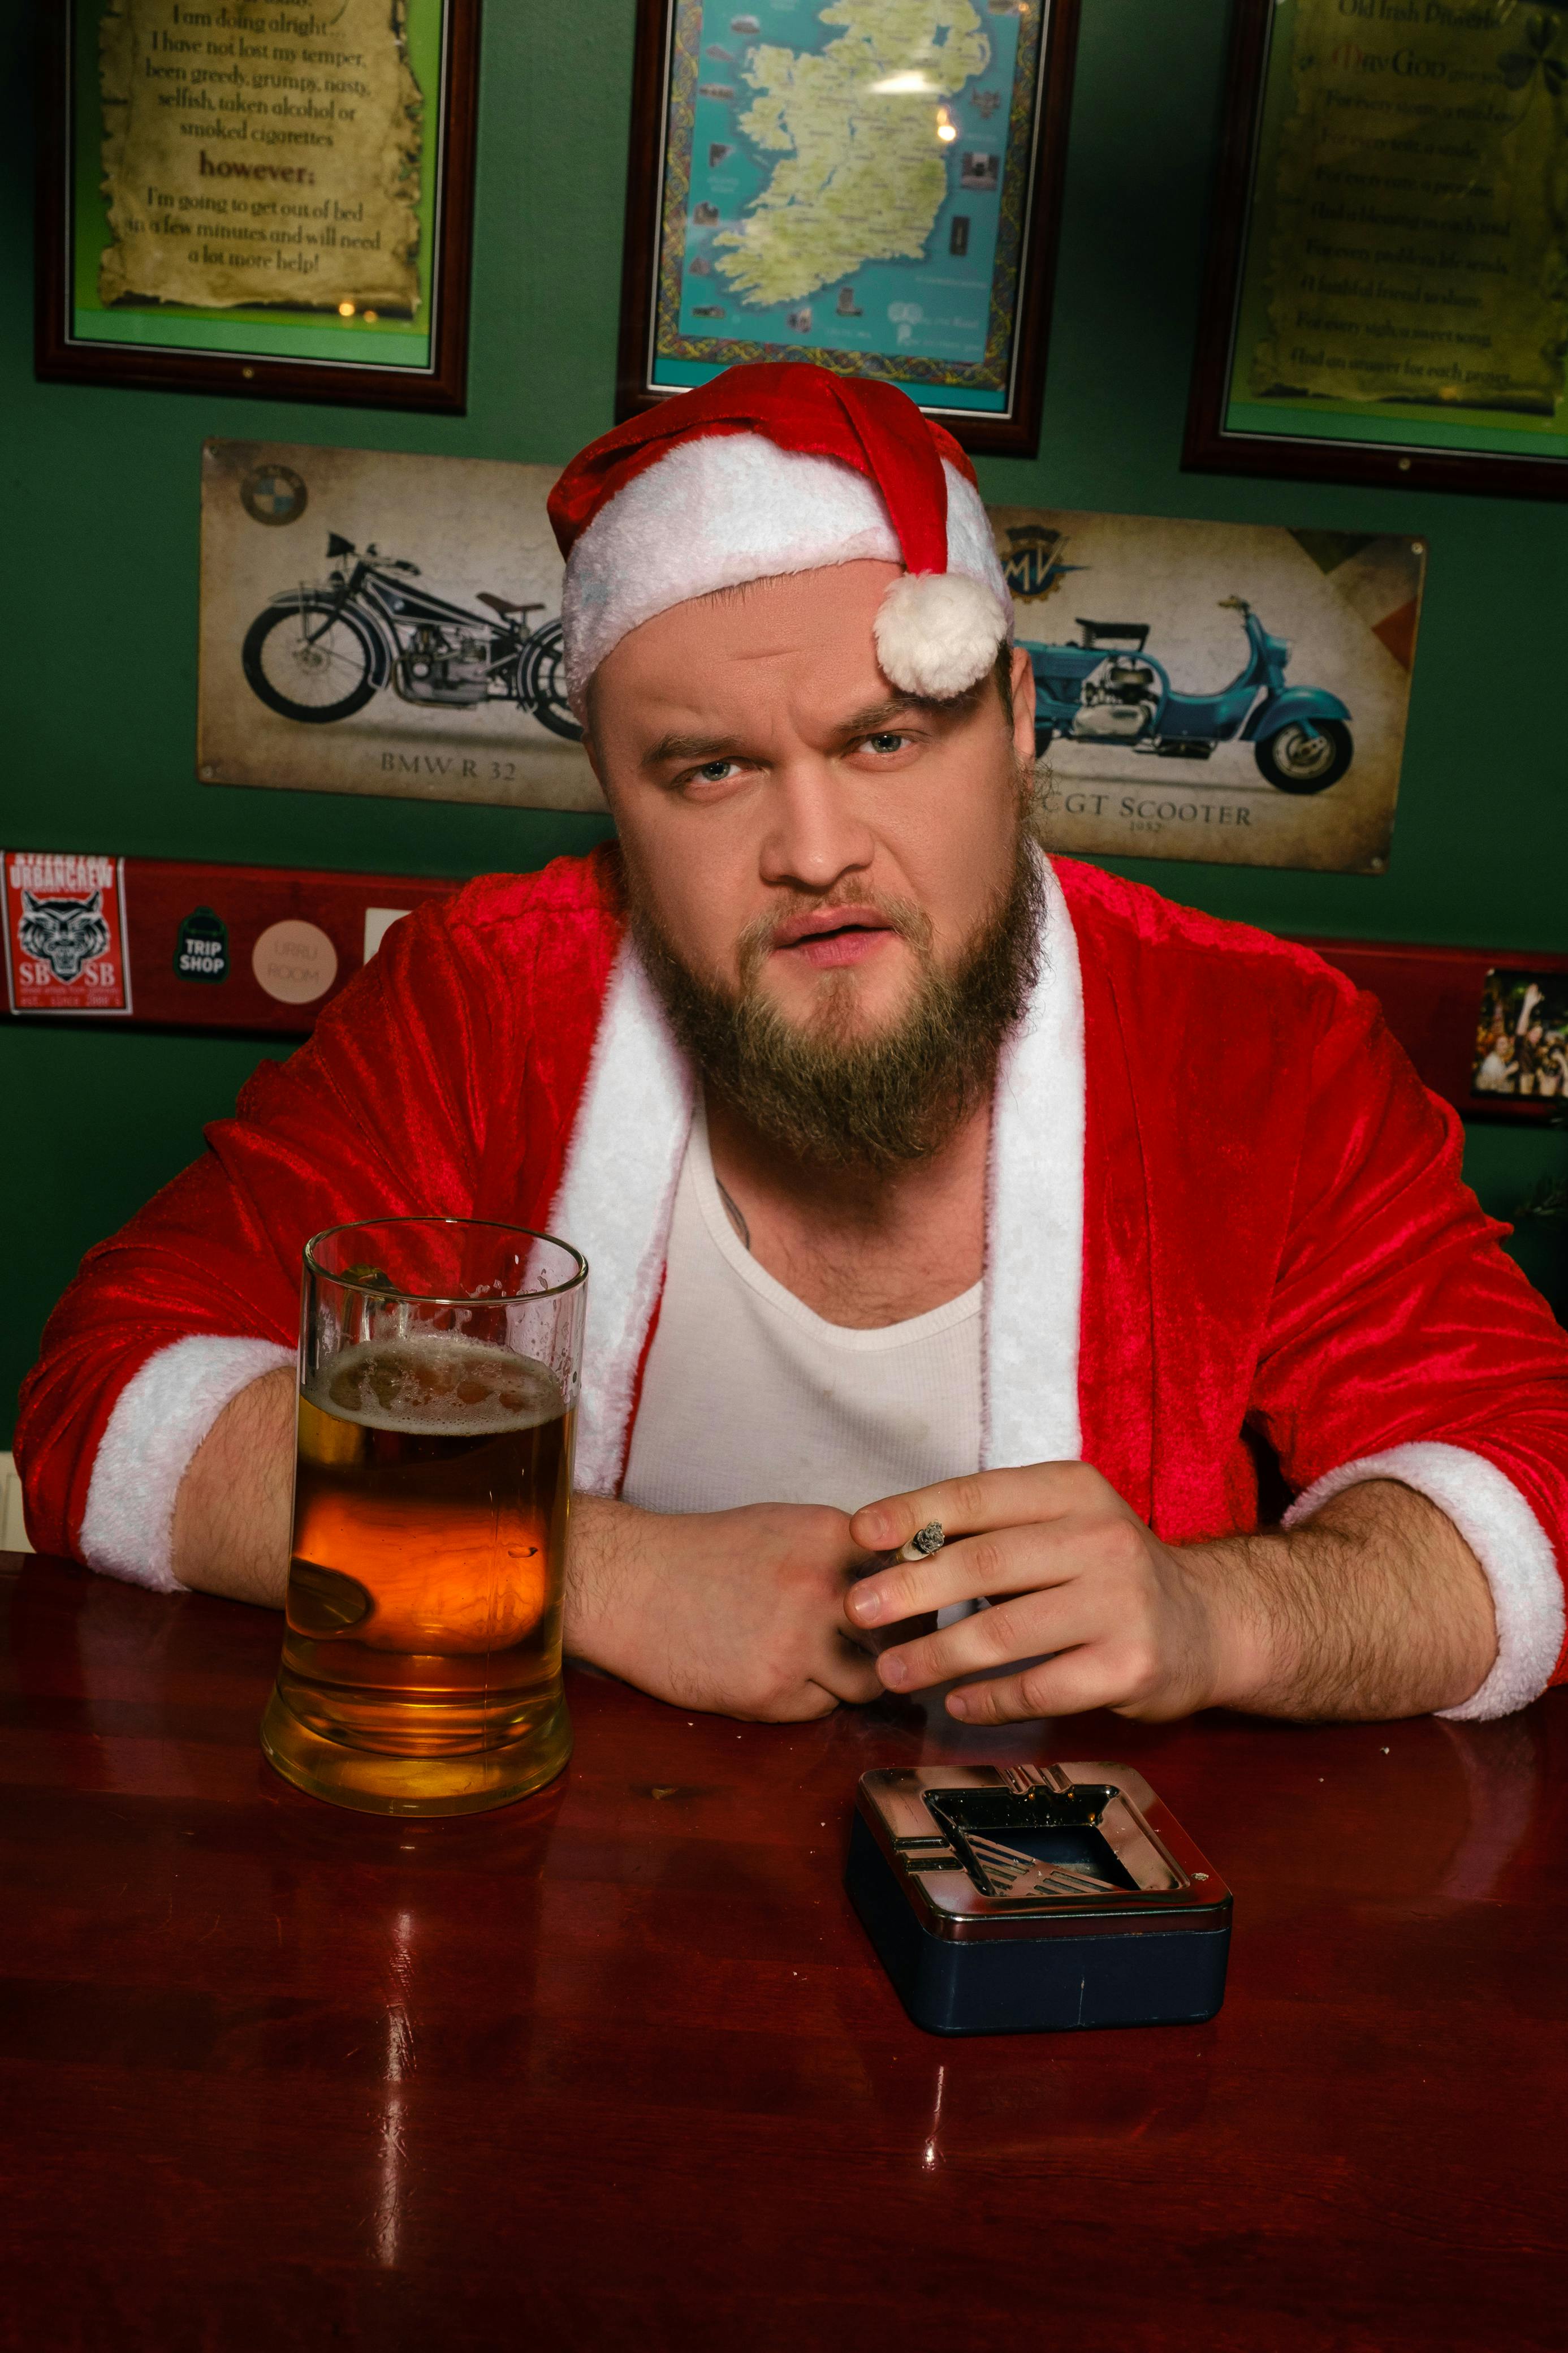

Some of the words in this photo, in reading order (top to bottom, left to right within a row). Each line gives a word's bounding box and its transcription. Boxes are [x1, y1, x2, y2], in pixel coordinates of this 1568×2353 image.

[172, 4, 180, 25] I
[183, 11, 212, 27] am
[215, 6, 266, 34] doing
[152, 30, 158, 51] I
[162, 30, 202, 53] have
[206, 37, 236, 57] not
[239, 36, 269, 59] lost
[272, 46, 297, 63] my
[145, 57, 187, 80] been
[219, 92, 269, 114] taken
[271, 96, 336, 120] alcohol
[338, 107, 357, 122] or
[179, 118, 248, 141] smoked
[250, 123, 335, 147] cigarettes
[198, 149, 316, 187] however:
[146, 186, 175, 209] I'm
[178, 195, 228, 214] going
[231, 198, 249, 213] to
[250, 200, 278, 218] get
[280, 202, 310, 218] out
[312, 198, 331, 221] of
[333, 200, 364, 222] bed
[127, 217, 146, 234] in
[150, 221, 161, 234] a
[163, 214, 192, 235] few
[196, 221, 268, 242] minutes
[269, 225, 303, 245] and
[305, 226, 337, 248] will
[340, 230, 382, 251] need
[187, 249, 199, 264] a
[202, 244, 225, 265] lot
[228, 251, 272, 269] more
[275, 249, 320, 275] help!
[381, 752, 453, 775] BMW
[462, 759, 478, 778] R
[490, 761, 517, 781] 32
[1041, 791, 1110, 816] CGT
[1119, 796, 1252, 826] SCOOTER
[185, 938, 223, 957] TRIP
[19, 962, 51, 986] SB
[84, 962, 115, 986] SB
[179, 953, 226, 973] SHOP
[267, 963, 320, 984] ROOM
